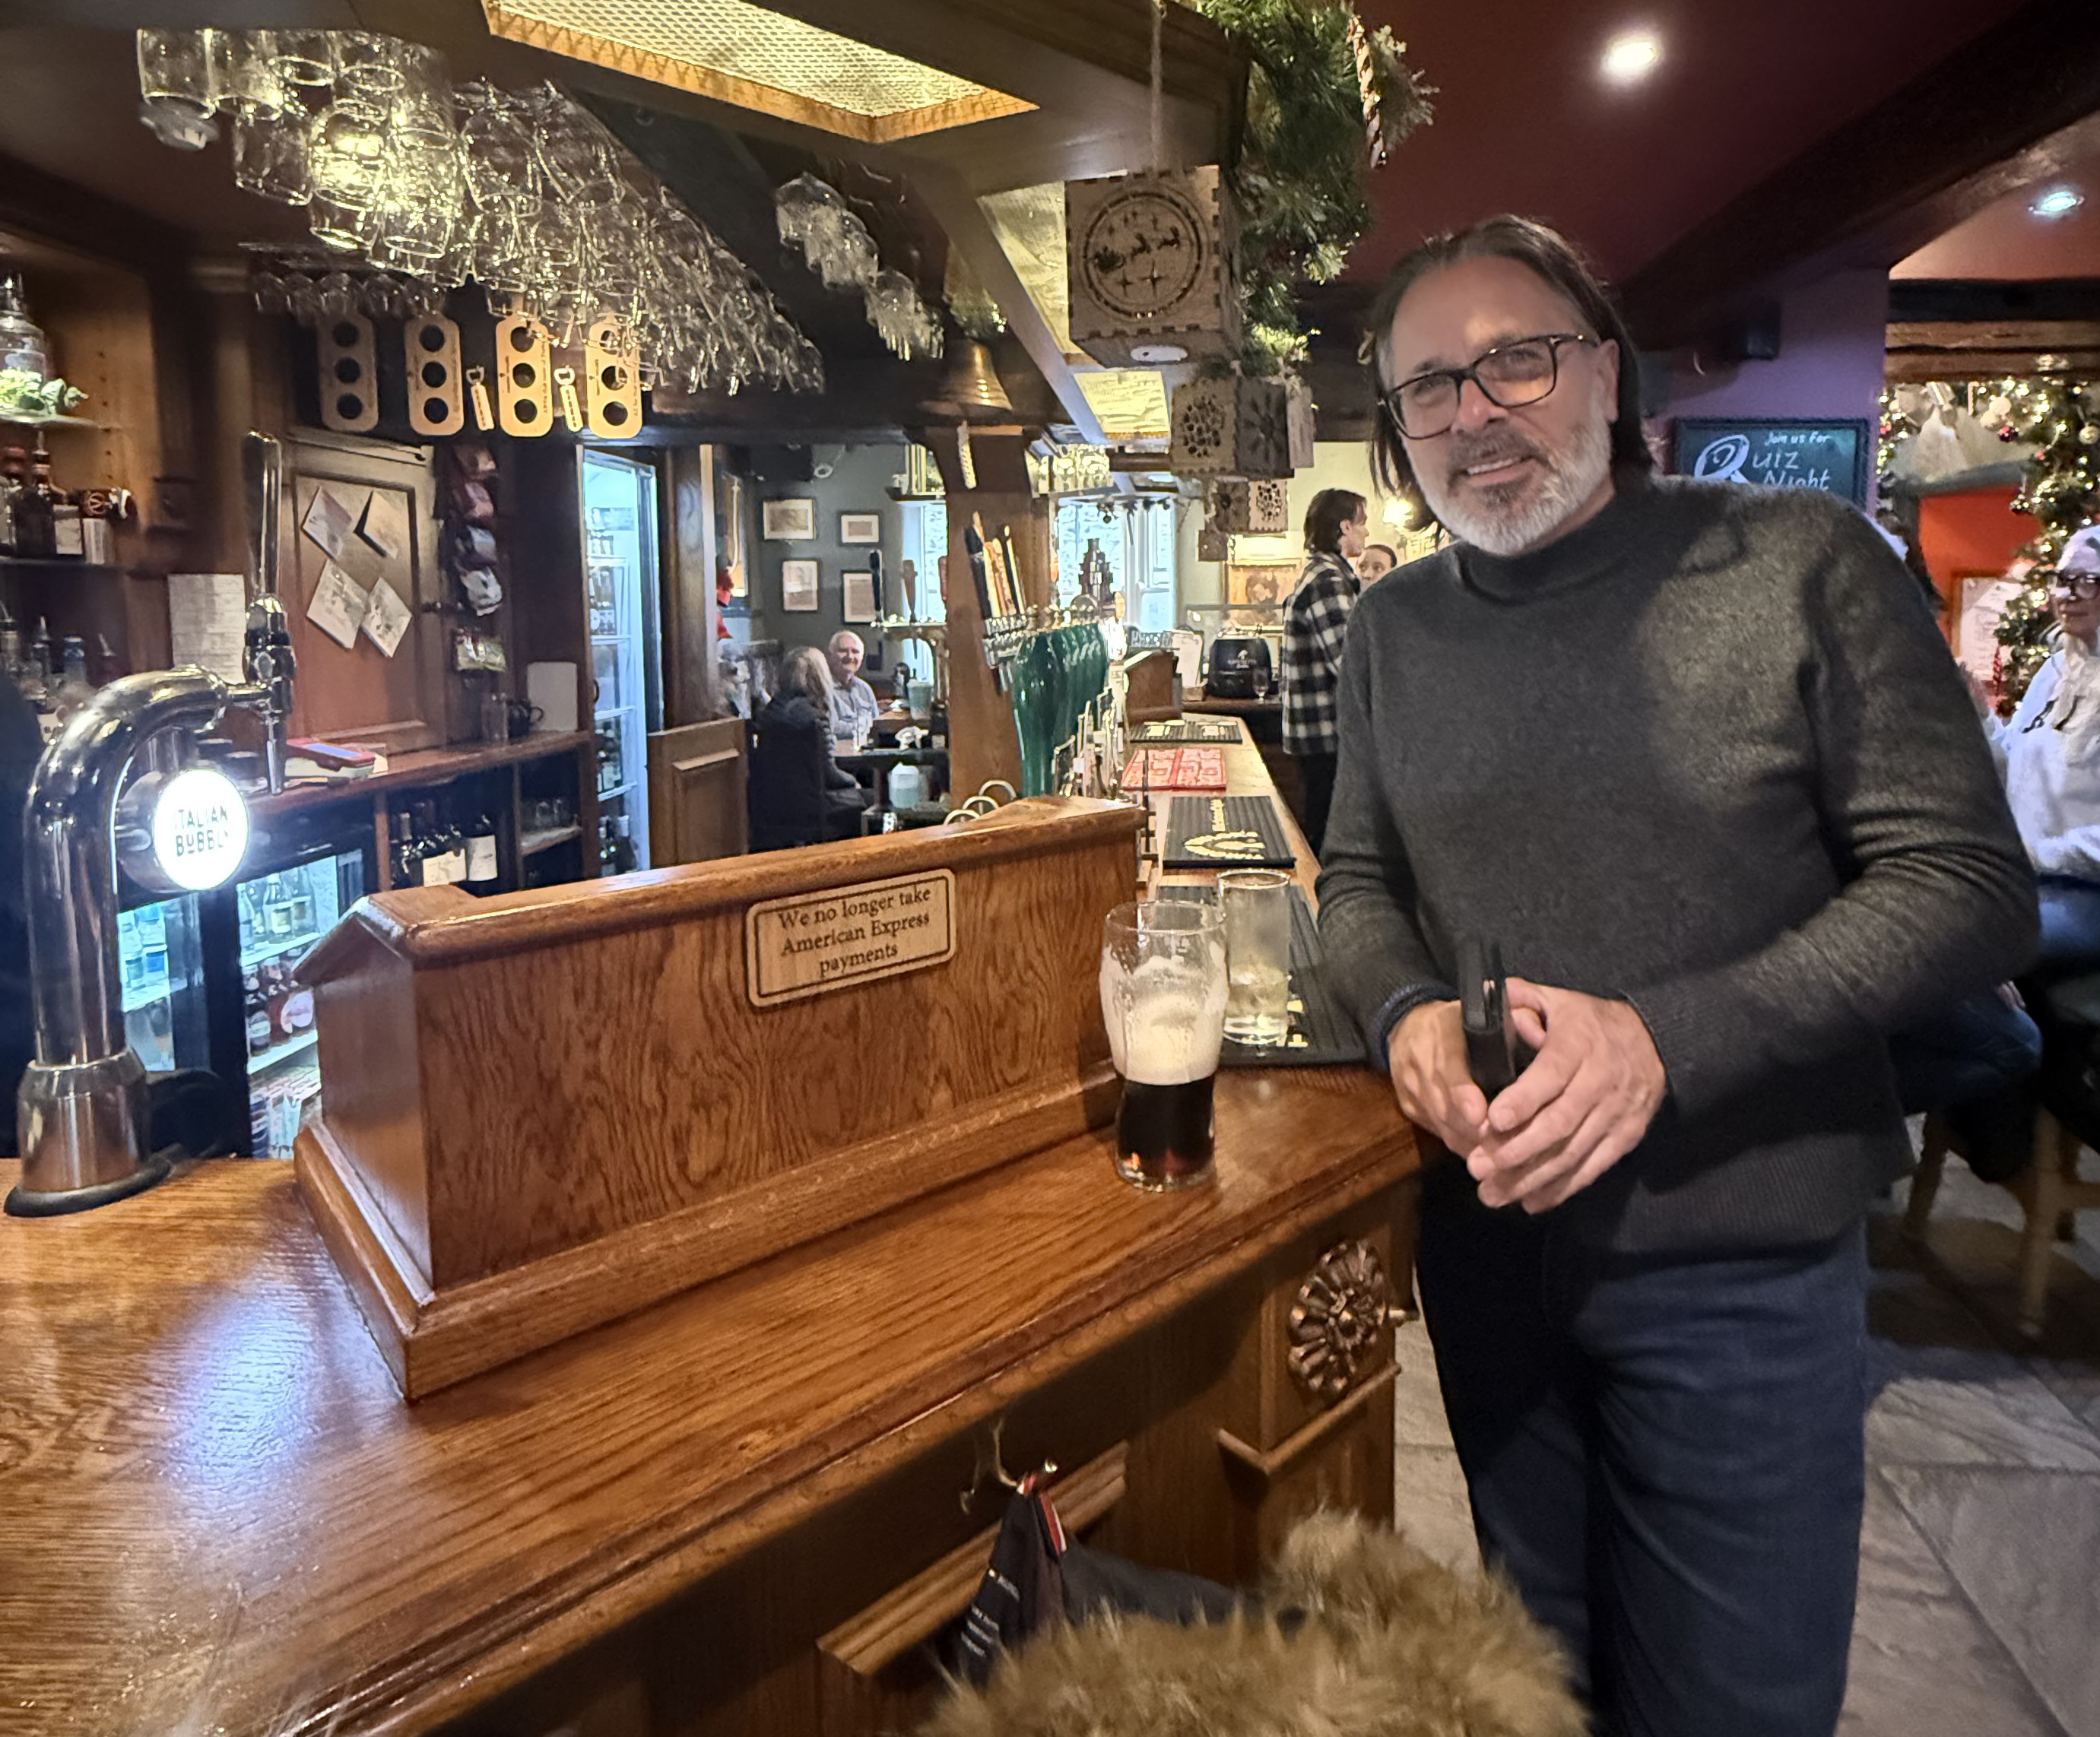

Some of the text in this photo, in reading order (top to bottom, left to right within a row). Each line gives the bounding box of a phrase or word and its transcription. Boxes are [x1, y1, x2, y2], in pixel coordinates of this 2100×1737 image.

[173, 805, 228, 829] ITALIAN
[778, 885, 931, 929] We no longer take
[781, 913, 930, 956] American Express
[819, 943, 899, 978] payments
